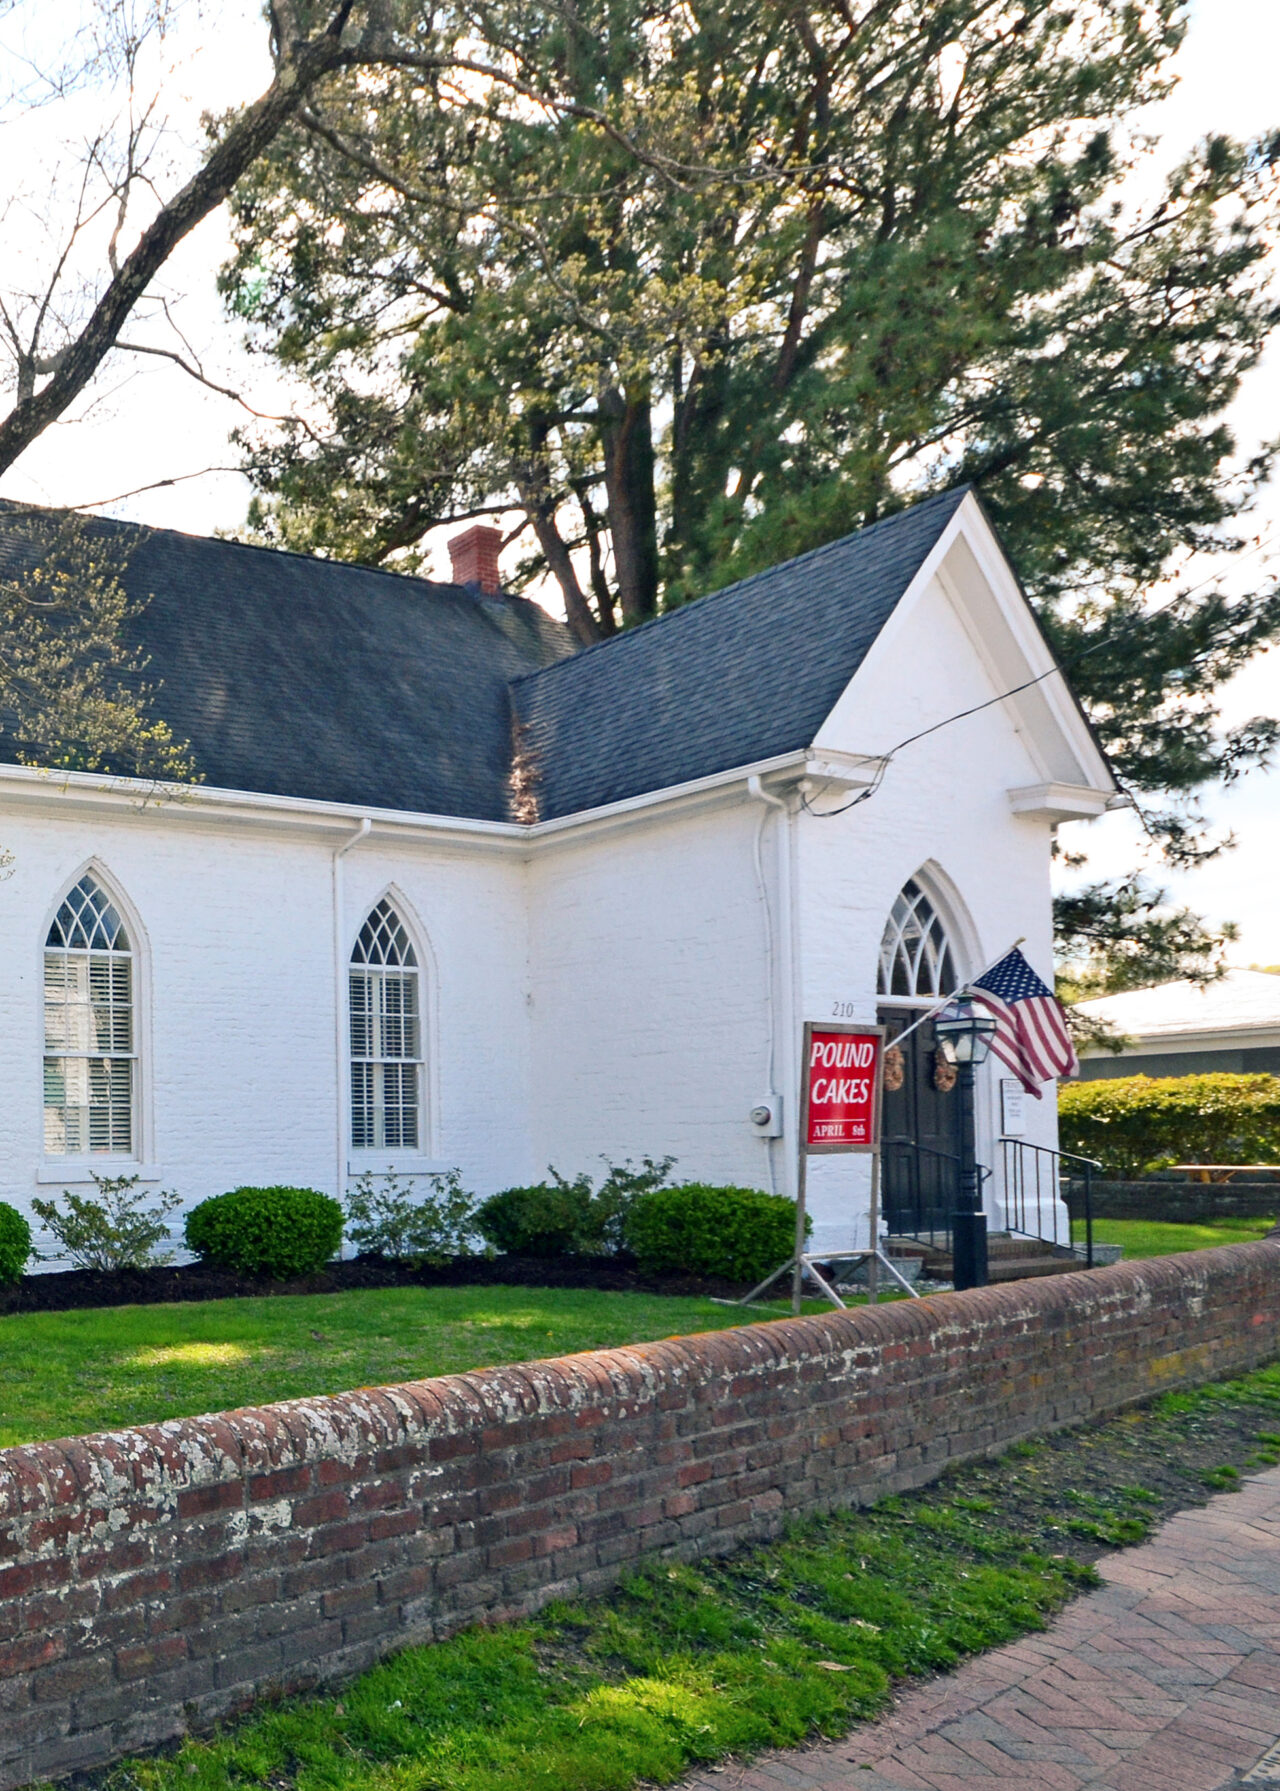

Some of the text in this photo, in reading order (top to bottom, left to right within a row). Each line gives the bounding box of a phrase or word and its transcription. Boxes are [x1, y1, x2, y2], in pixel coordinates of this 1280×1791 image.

[832, 1001, 854, 1018] 210
[810, 1042, 874, 1068] POUND
[812, 1079, 870, 1104] CAKES
[813, 1125, 845, 1137] APRIL
